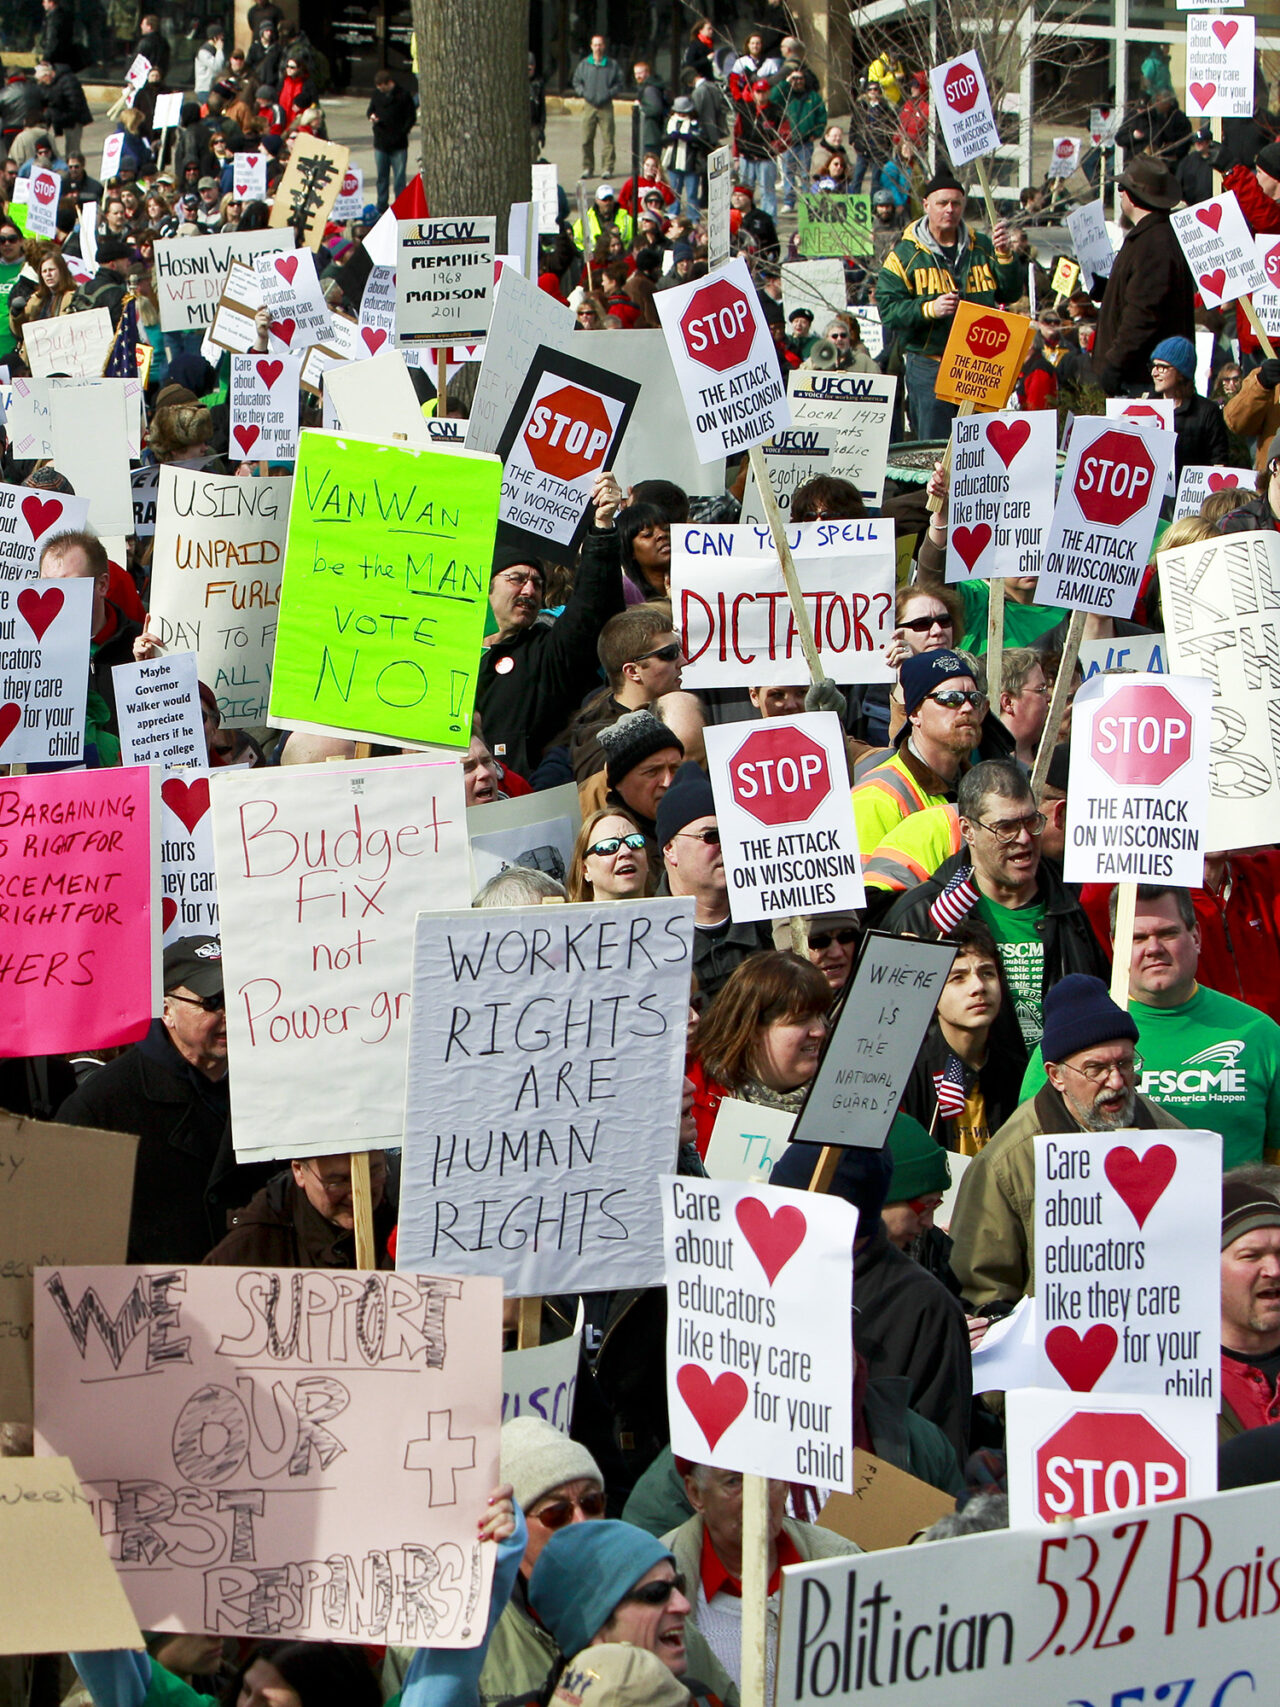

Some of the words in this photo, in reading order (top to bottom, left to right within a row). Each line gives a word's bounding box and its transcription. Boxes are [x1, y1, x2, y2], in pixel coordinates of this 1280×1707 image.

[1191, 18, 1208, 31] Care
[1190, 35, 1211, 47] about
[1190, 51, 1227, 64] educators
[1190, 67, 1203, 80] like
[1205, 68, 1221, 82] they
[1223, 70, 1239, 81] care
[946, 74, 975, 102] STOP
[1218, 84, 1228, 97] for
[1230, 86, 1246, 98] your
[1233, 102, 1251, 114] child
[953, 121, 965, 134] THE
[966, 111, 987, 129] ATTACK
[953, 137, 962, 148] ON
[960, 122, 994, 145] WISCONSIN
[963, 139, 989, 156] FAMILIES
[34, 181, 56, 195] STOP
[418, 224, 475, 240] UFCW
[433, 272, 462, 284] 1968
[432, 306, 460, 318] 2011
[970, 327, 1007, 348] STOP
[955, 355, 971, 369] THE
[971, 360, 1004, 376] ATTACK
[811, 377, 873, 395] UFCW
[950, 367, 964, 379] ON
[965, 371, 1000, 388] WORKER
[955, 382, 987, 398] RIGHTS
[853, 410, 886, 424] 1473
[527, 405, 609, 461] STOP
[771, 431, 818, 449] UFCW
[509, 464, 532, 485] THE
[537, 478, 587, 505] ATTACK
[174, 475, 278, 518] USING
[507, 506, 555, 534] RIGHTS
[685, 530, 734, 556] CAN
[817, 523, 878, 546] SPELL
[175, 533, 281, 570] UNPAID
[313, 539, 345, 575] be
[358, 553, 395, 579] the
[407, 554, 482, 592] MAN
[160, 616, 201, 651] DAY
[218, 626, 248, 649] TO
[334, 605, 438, 646] VOTE
[140, 665, 171, 679] Maybe
[135, 680, 179, 696] Governor
[126, 700, 160, 715] Walker
[162, 693, 191, 708] would
[137, 713, 184, 730] appreciate
[131, 731, 170, 747] teachers
[172, 729, 180, 740] if
[182, 726, 194, 737] he
[1096, 716, 1186, 754] STOP
[134, 748, 151, 763] had
[154, 750, 160, 758] a
[163, 742, 195, 758] college
[239, 797, 453, 881] Budget
[296, 869, 386, 923] Fix
[312, 930, 376, 971] not
[447, 915, 689, 982] WORKERS
[870, 963, 938, 988] WHERE
[445, 994, 667, 1062] RIGHTS
[857, 1038, 888, 1057] THE
[515, 1057, 617, 1111] ARE
[835, 1070, 892, 1087] NATIONAL
[1164, 1094, 1207, 1102] America
[1209, 1093, 1246, 1102] Happen
[433, 1120, 601, 1186] HUMAN
[432, 1188, 630, 1257] RIGHTS
[45, 1270, 193, 1370] WE
[215, 1272, 463, 1369] SUPPORT
[172, 1376, 350, 1486] OUR
[1045, 1455, 1180, 1515] STOP
[204, 1542, 483, 1643] RESPONDERS!
[795, 1570, 1014, 1701] Politician
